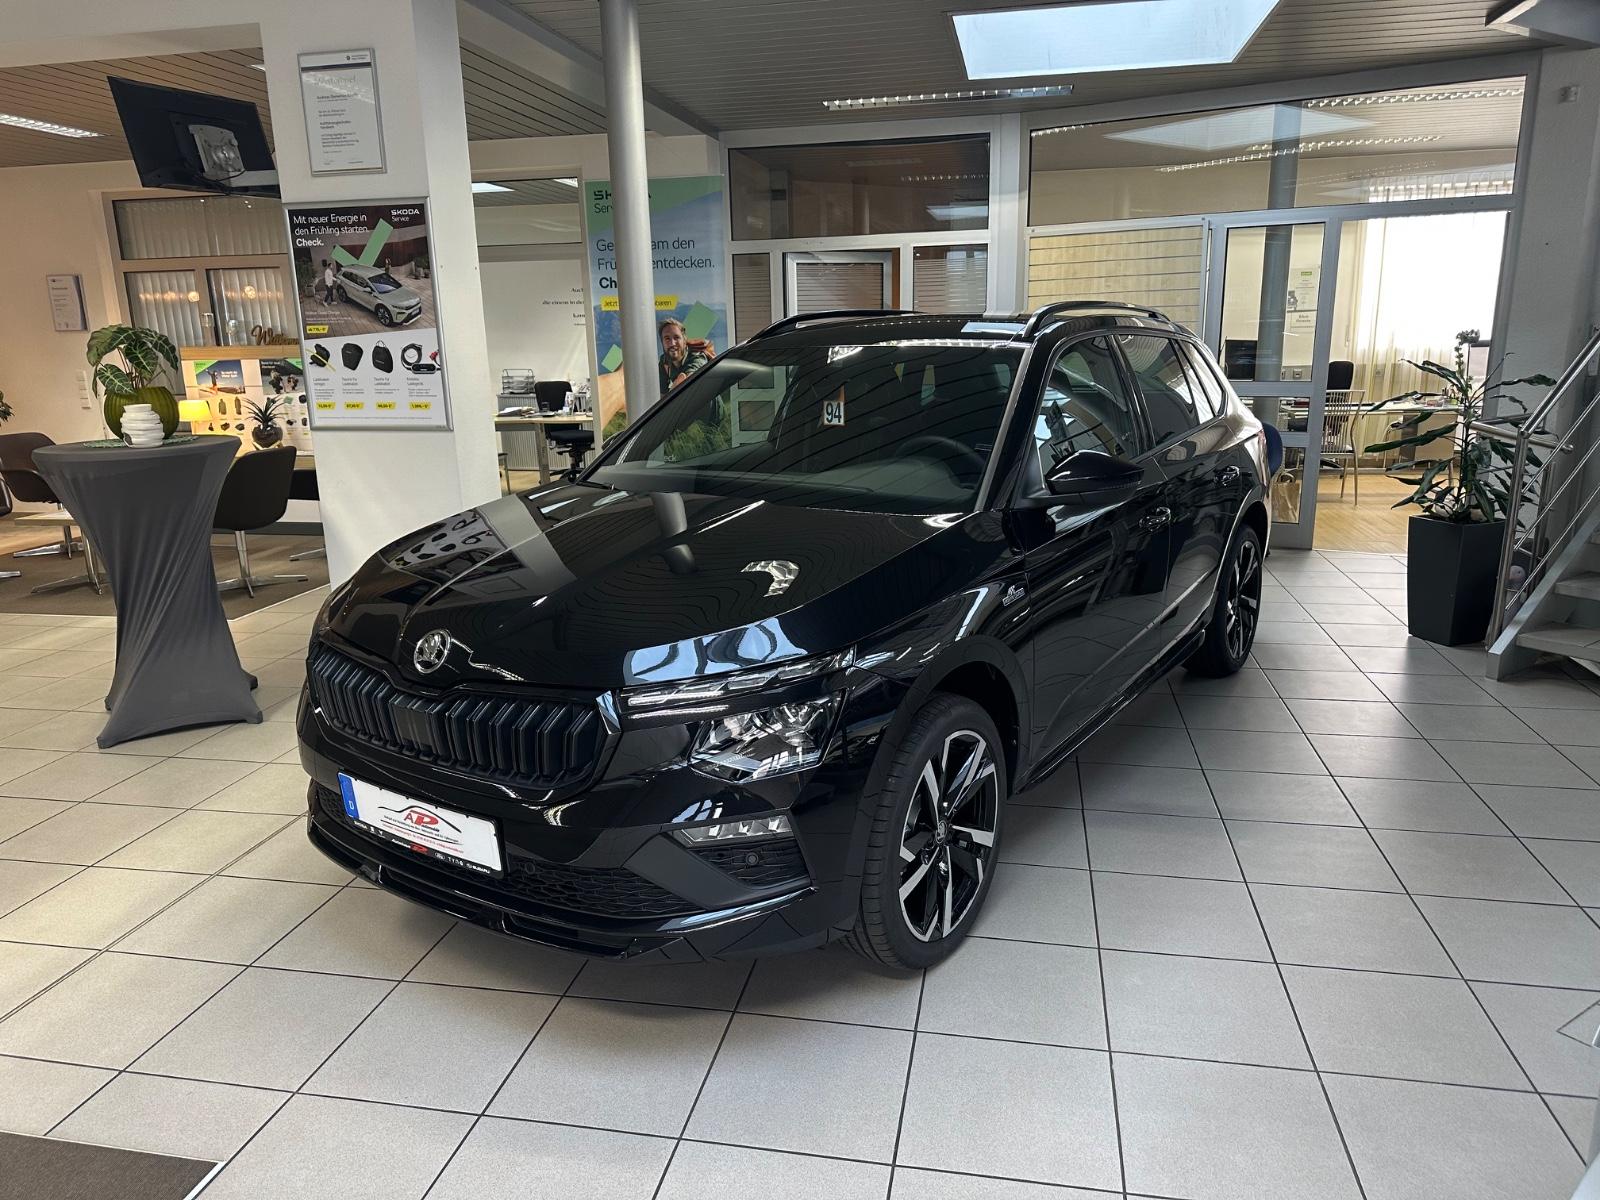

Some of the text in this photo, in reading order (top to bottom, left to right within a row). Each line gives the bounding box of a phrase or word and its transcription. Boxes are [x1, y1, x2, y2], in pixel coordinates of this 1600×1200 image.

[293, 215, 307, 224] Mit
[330, 213, 359, 224] Energie
[360, 213, 367, 221] in
[295, 225, 370, 236] den Frühling starten.
[296, 237, 325, 247] Check.
[672, 236, 695, 250] den
[652, 255, 715, 270] entdecken.
[825, 401, 843, 424] 94
[348, 800, 355, 810] D
